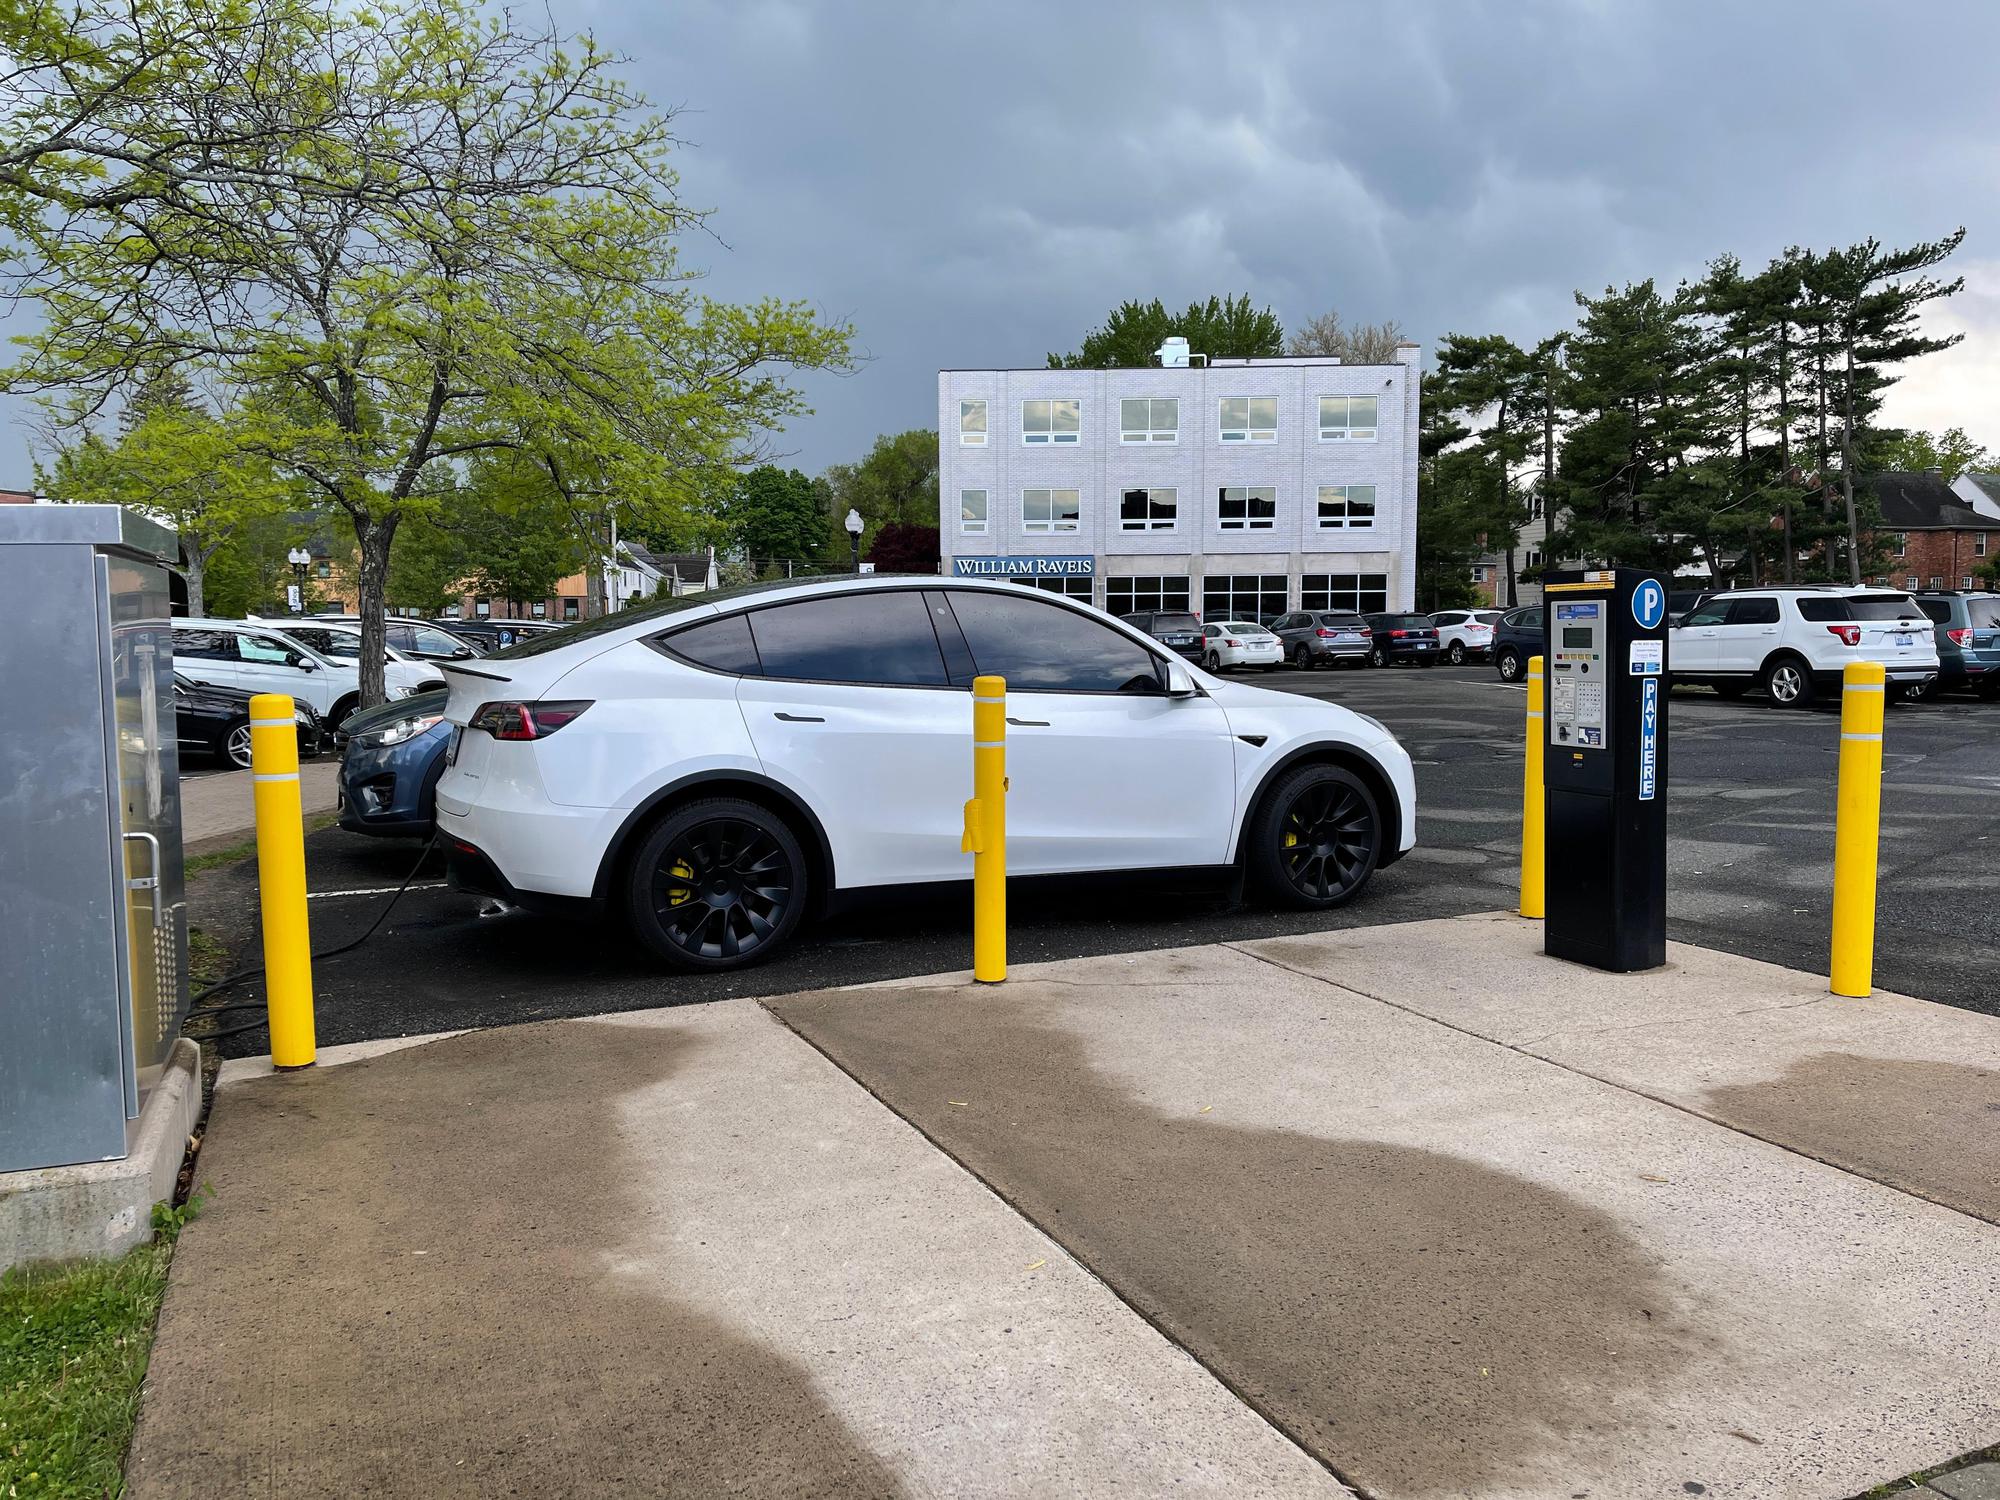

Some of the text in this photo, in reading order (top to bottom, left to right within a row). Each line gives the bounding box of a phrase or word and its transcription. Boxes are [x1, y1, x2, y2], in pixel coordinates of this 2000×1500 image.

[956, 559, 1092, 574] WILLIAM RAVEIS
[1644, 588, 1658, 621] P
[1645, 683, 1655, 728] PAY
[1643, 735, 1654, 795] HERE
